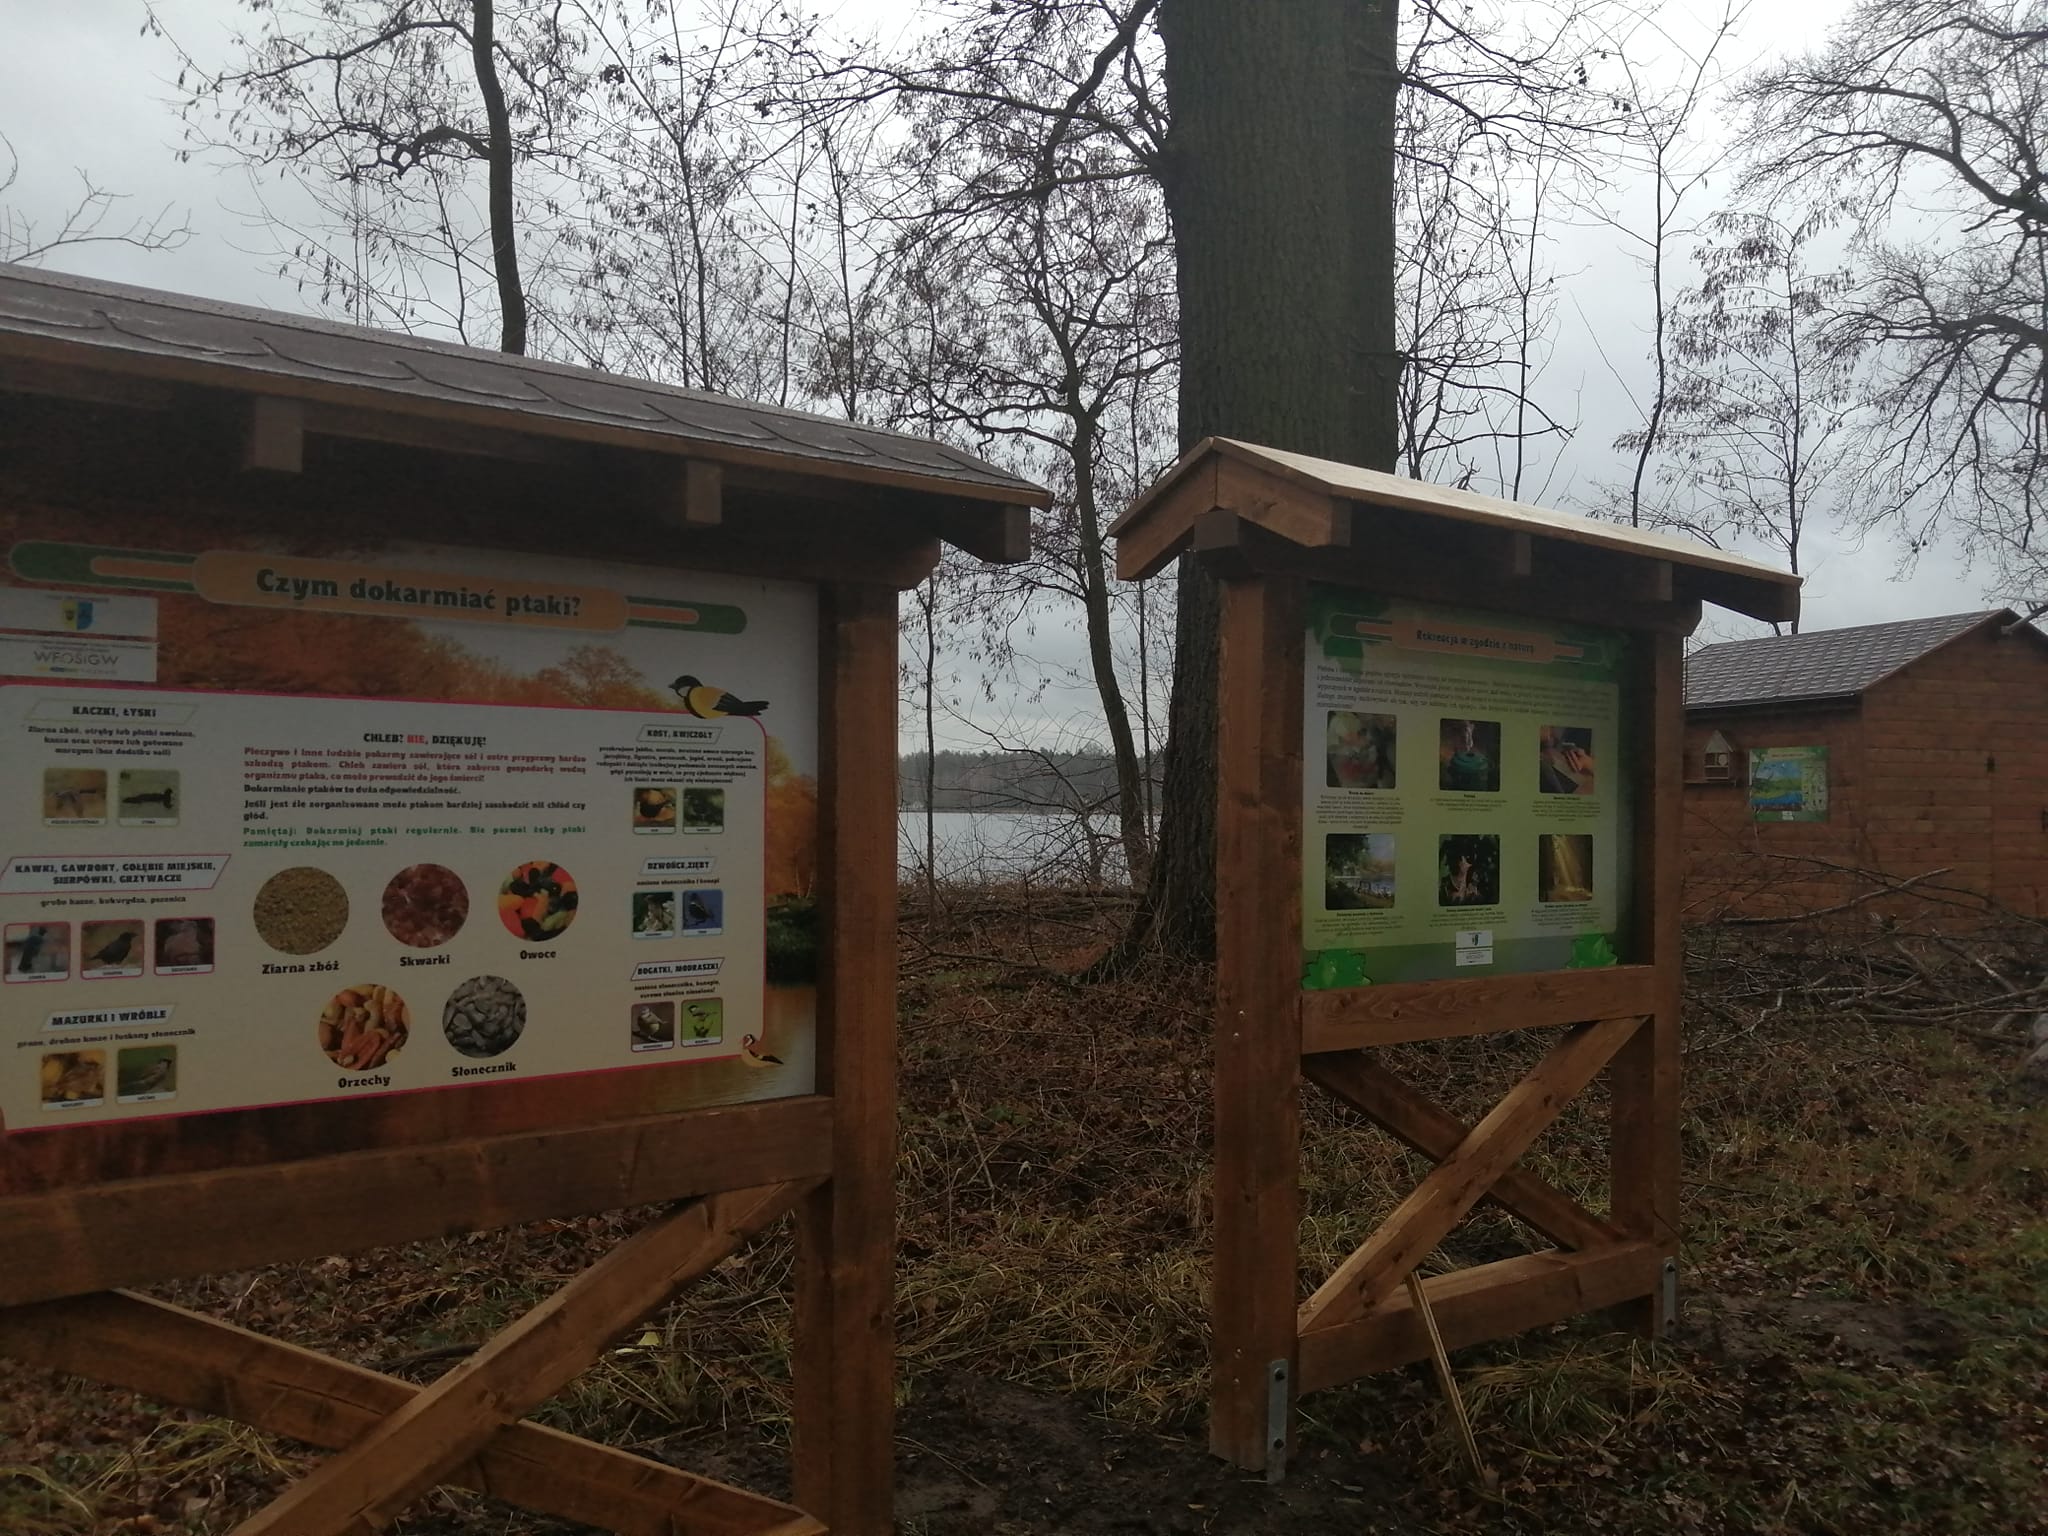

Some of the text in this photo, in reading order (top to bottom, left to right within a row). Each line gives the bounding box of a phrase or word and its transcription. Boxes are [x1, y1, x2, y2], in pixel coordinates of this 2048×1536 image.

[255, 568, 582, 617] Czym dokarmiać ptaki?
[72, 705, 157, 718] KACZKI, ŁYSKI
[363, 733, 404, 744] CHLEB?
[432, 735, 487, 748] DZIĘKUJĘ!
[672, 730, 713, 740] KWICZOŁY
[244, 747, 290, 758] Pieczywo
[301, 748, 323, 757] inne
[327, 749, 361, 758] ludzkie
[365, 750, 406, 760] pokarmy
[558, 754, 587, 763] bardzo
[244, 760, 284, 770] szkodzą
[291, 760, 331, 770] ptakom.
[338, 760, 365, 770] Chleb
[372, 761, 407, 770] zawiera
[436, 763, 461, 772] która
[467, 763, 500, 773] zaburza
[506, 764, 554, 775] gospodarkę
[244, 772, 297, 781] organizmu
[299, 772, 329, 781] ptaka,
[330, 773, 341, 781] co
[369, 773, 415, 783] prowadzić
[417, 774, 428, 782] do
[429, 774, 448, 783] jego
[244, 784, 461, 796] Dokarmianie ptaków to duża odpowiedzialność.
[244, 800, 266, 809] Jeśli
[270, 800, 288, 810] jest
[309, 800, 380, 811] zorganizowane
[382, 801, 407, 810] może
[409, 801, 444, 811] ptakom
[446, 801, 483, 811] bardziej
[485, 801, 530, 810] zaszkodzić
[532, 801, 545, 810] niż
[547, 801, 570, 810] chłód
[572, 802, 586, 811] czy
[243, 812, 269, 821] głód.
[243, 827, 296, 837] Pamiętaj:
[306, 826, 362, 837] Dokarmiaj
[370, 826, 397, 837] ptaki
[406, 826, 462, 837] regularnie.
[561, 826, 586, 836] ptaki
[243, 839, 289, 849] zamarzły
[290, 838, 330, 849] czekając
[345, 838, 388, 849] jedzenie.
[14, 861, 217, 874] KAWKI, GAWRONY, GOŁĘBIE MIEJSKIE,
[52, 873, 182, 885] SIERPÓWKI, GRZYWACZE
[399, 954, 451, 967] Skwarki
[519, 949, 557, 961] Owoce
[261, 960, 340, 975] Ziarna zbóż
[637, 962, 719, 976] BOGATKI, MODRASZKI
[51, 1009, 167, 1027] MAZURKI I WRÓBLE
[452, 1061, 517, 1078] Słonecznik
[337, 1074, 391, 1089] Orzechy
